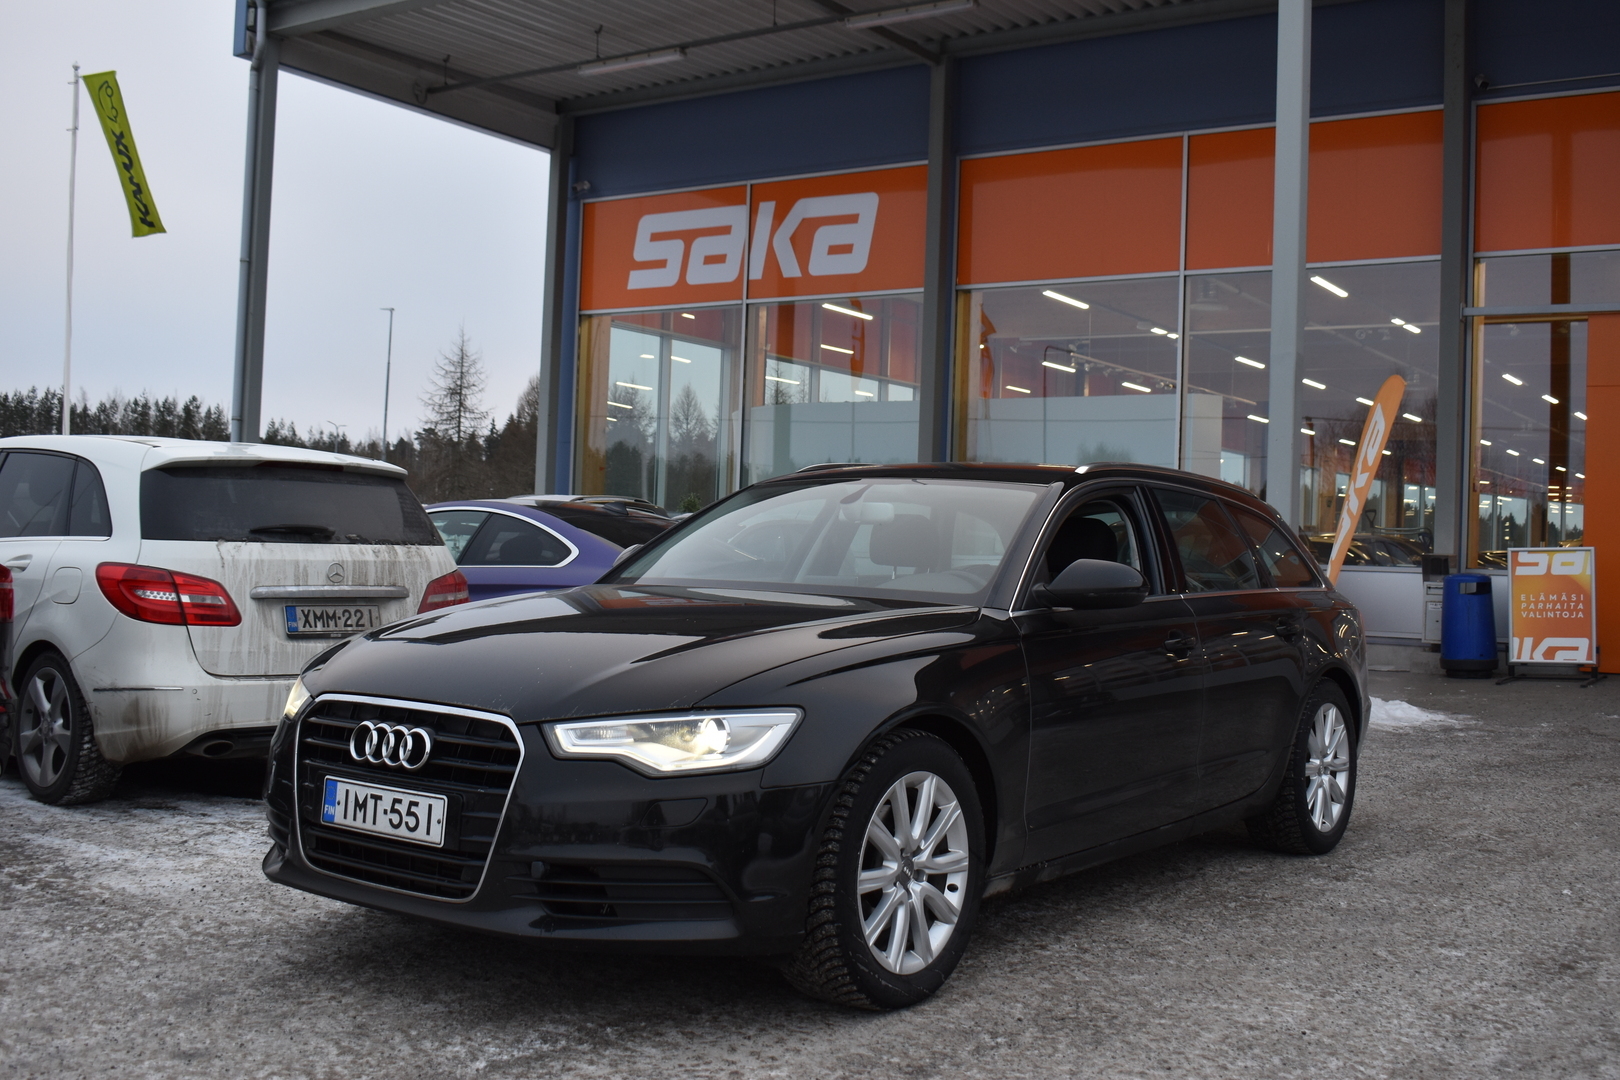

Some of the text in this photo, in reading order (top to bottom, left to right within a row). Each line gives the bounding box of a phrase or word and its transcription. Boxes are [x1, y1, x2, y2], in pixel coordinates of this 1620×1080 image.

[1520, 593, 1584, 601] ELÄMÄSI
[301, 609, 373, 628] XMM-221
[324, 804, 336, 815] FIN
[343, 789, 433, 836] IMT-551
